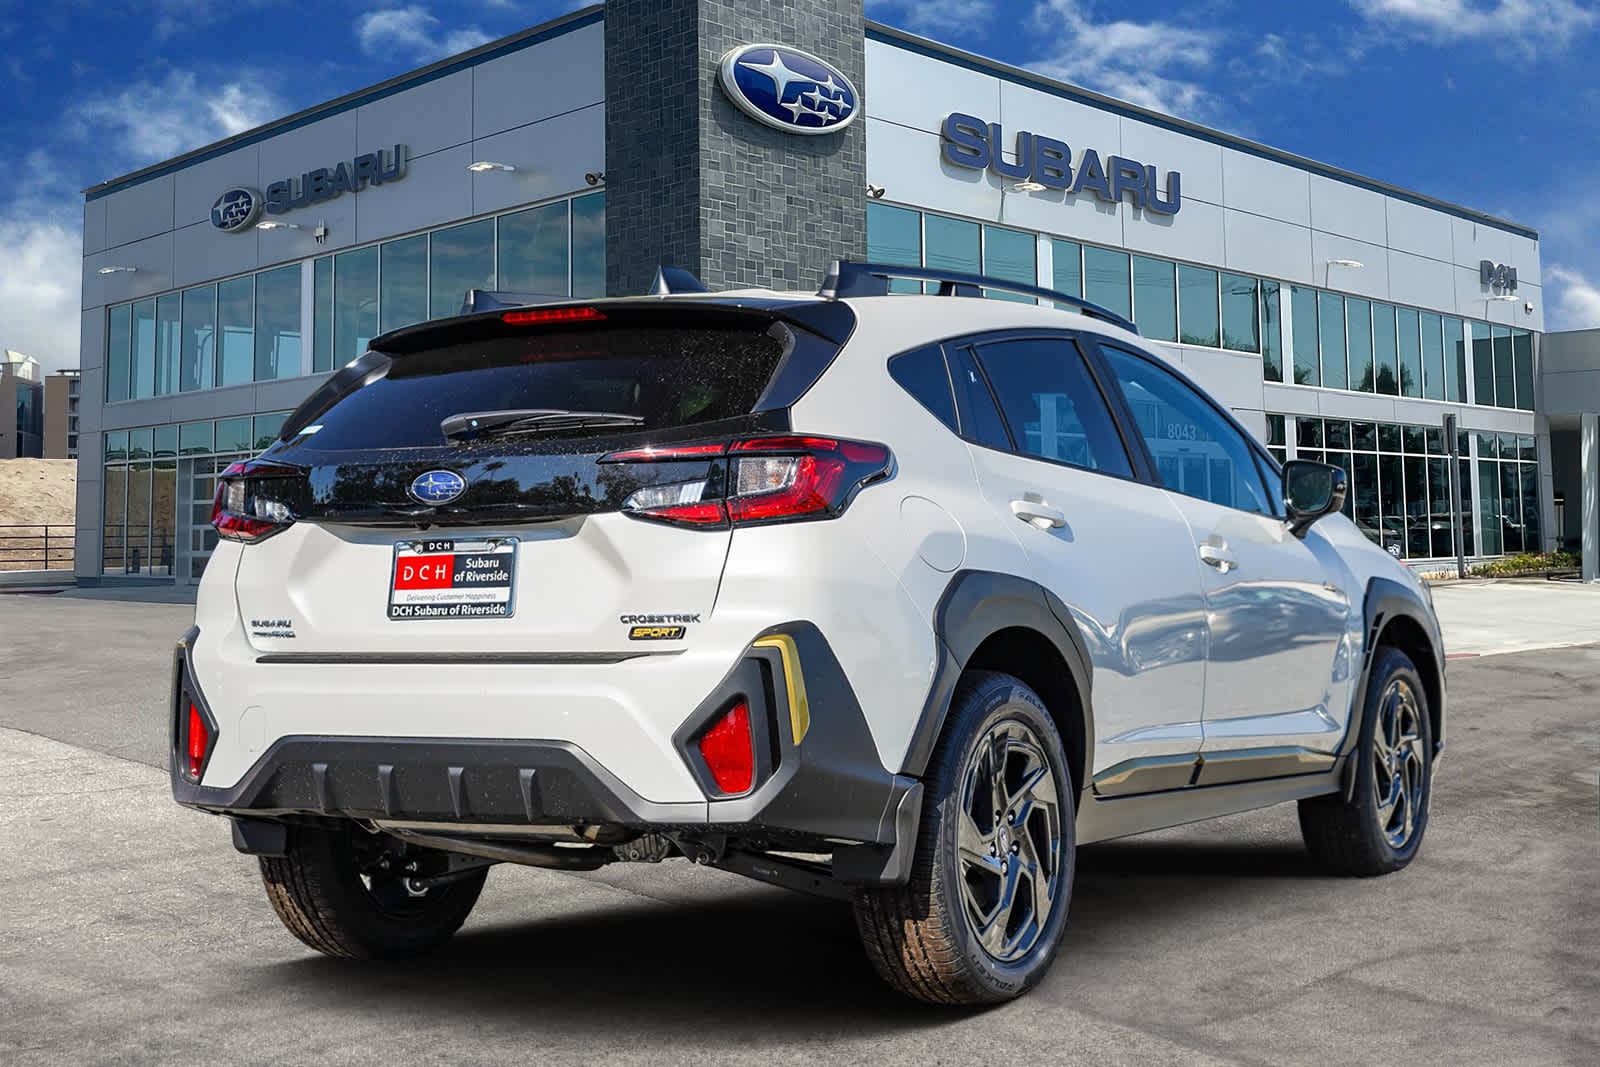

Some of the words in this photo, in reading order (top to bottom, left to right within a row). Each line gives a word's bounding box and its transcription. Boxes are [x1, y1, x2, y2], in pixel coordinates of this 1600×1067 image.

[942, 112, 1181, 215] SUBARU
[266, 144, 405, 215] SUBARU
[1167, 423, 1197, 440] 8043
[428, 541, 451, 550] DCH
[466, 557, 499, 569] Subaru
[403, 564, 447, 581] DCH
[454, 572, 464, 582] of
[466, 570, 509, 581] Riverside
[436, 593, 464, 601] Customer
[392, 606, 413, 616] DCH
[414, 605, 448, 616] Subaru
[449, 604, 460, 615] of
[461, 603, 505, 615] Riverside
[251, 619, 292, 628] SUBARU
[620, 613, 701, 624] CROSSTREK
[632, 627, 679, 637] SPORT
